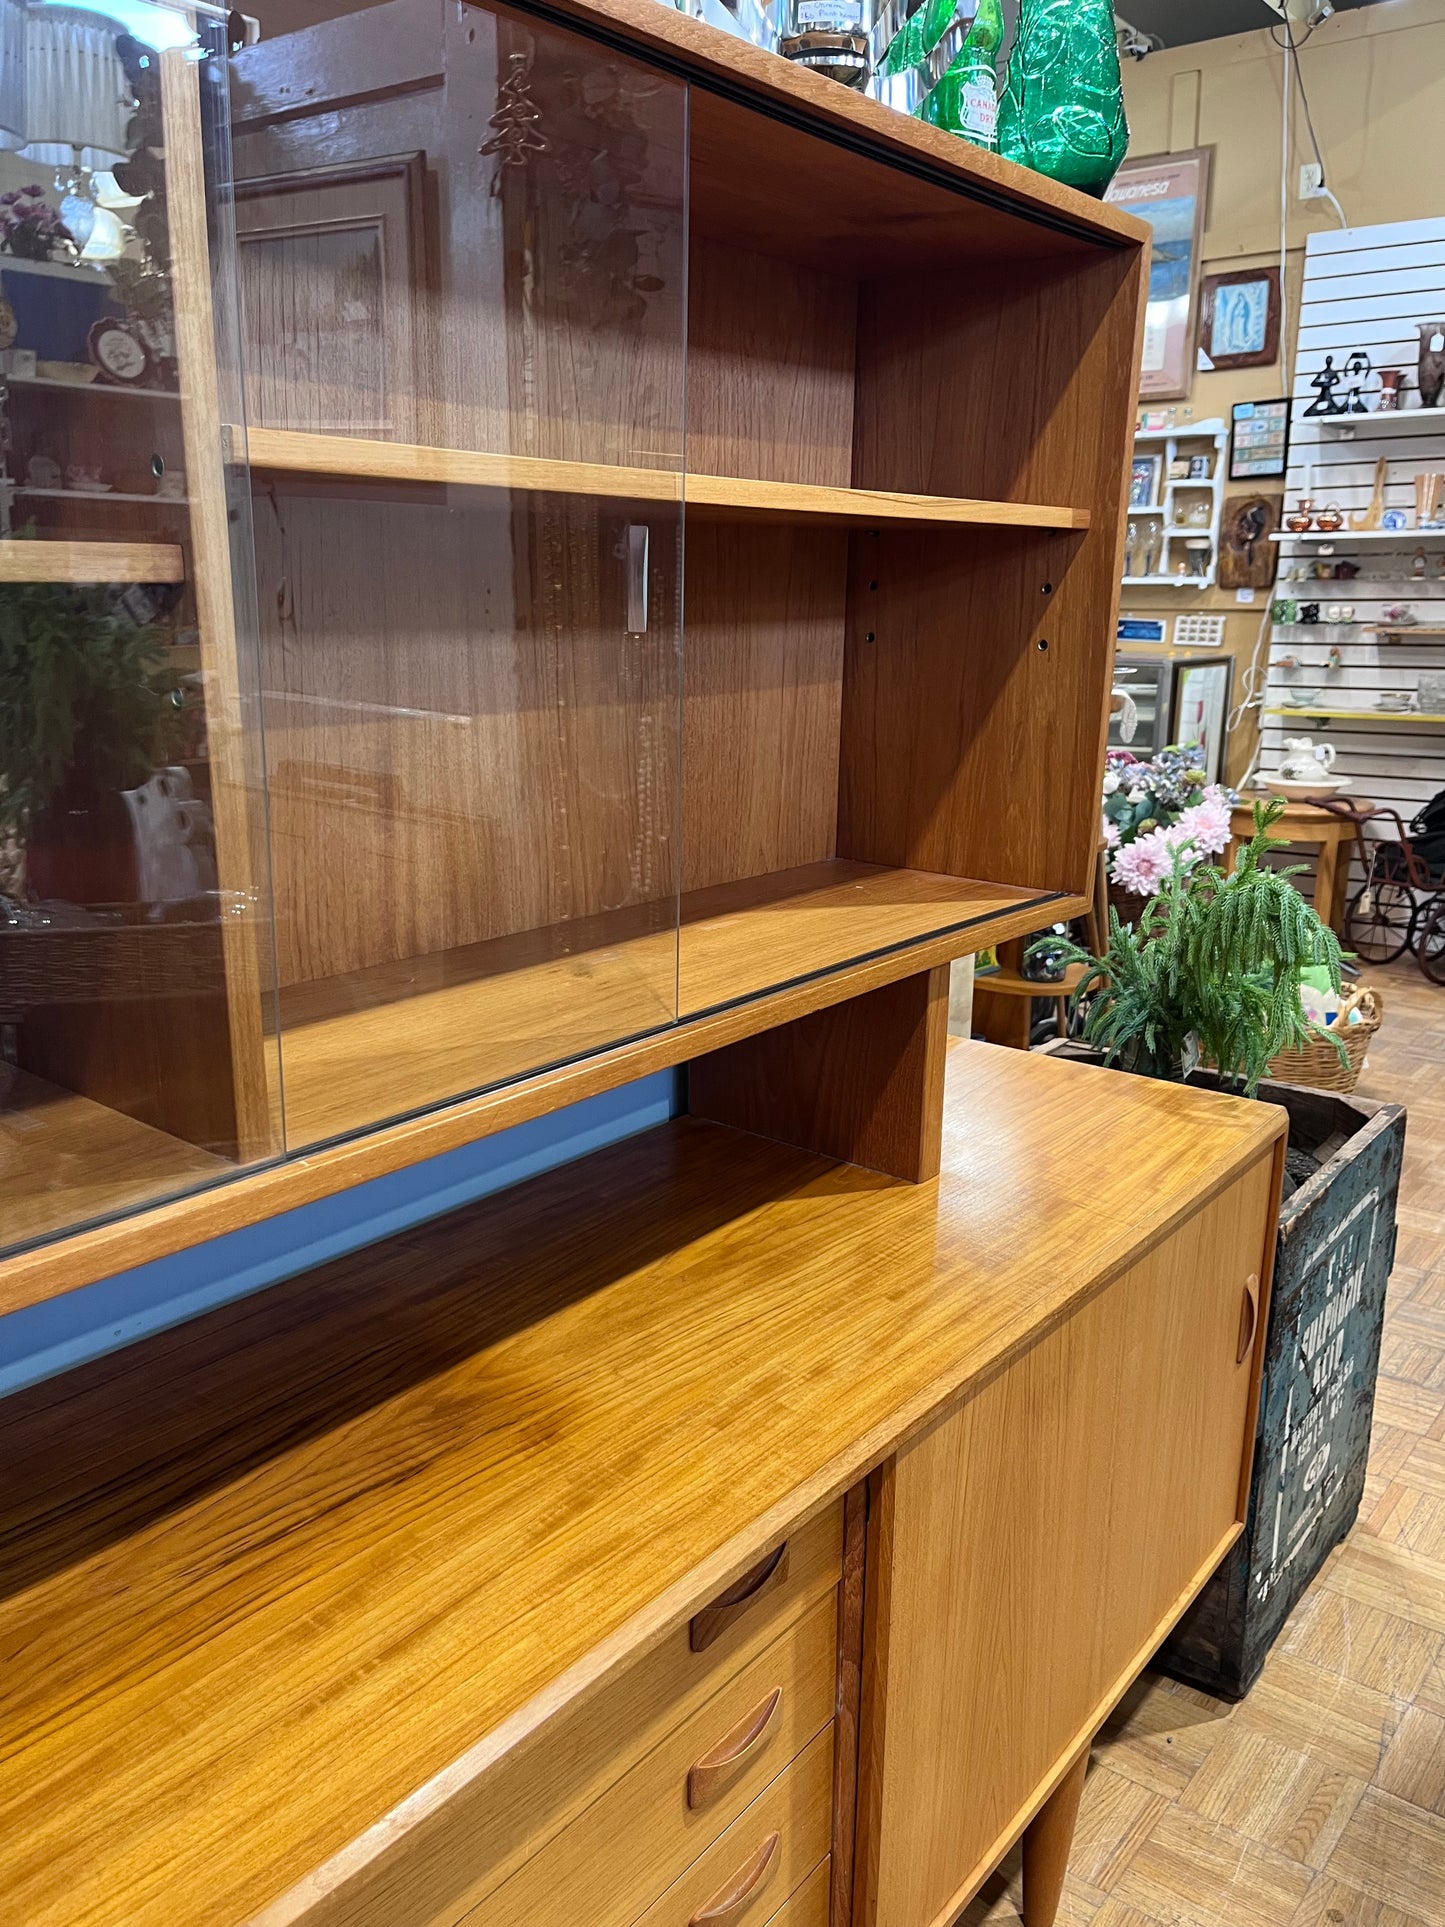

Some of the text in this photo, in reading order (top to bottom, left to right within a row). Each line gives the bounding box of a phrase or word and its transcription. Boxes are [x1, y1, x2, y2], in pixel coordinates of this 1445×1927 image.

[970, 98, 995, 112] CANAD
[980, 113, 993, 125] DRY
[1299, 1261, 1366, 1372] SULPHURIC
[1310, 1328, 1345, 1402] ACID
